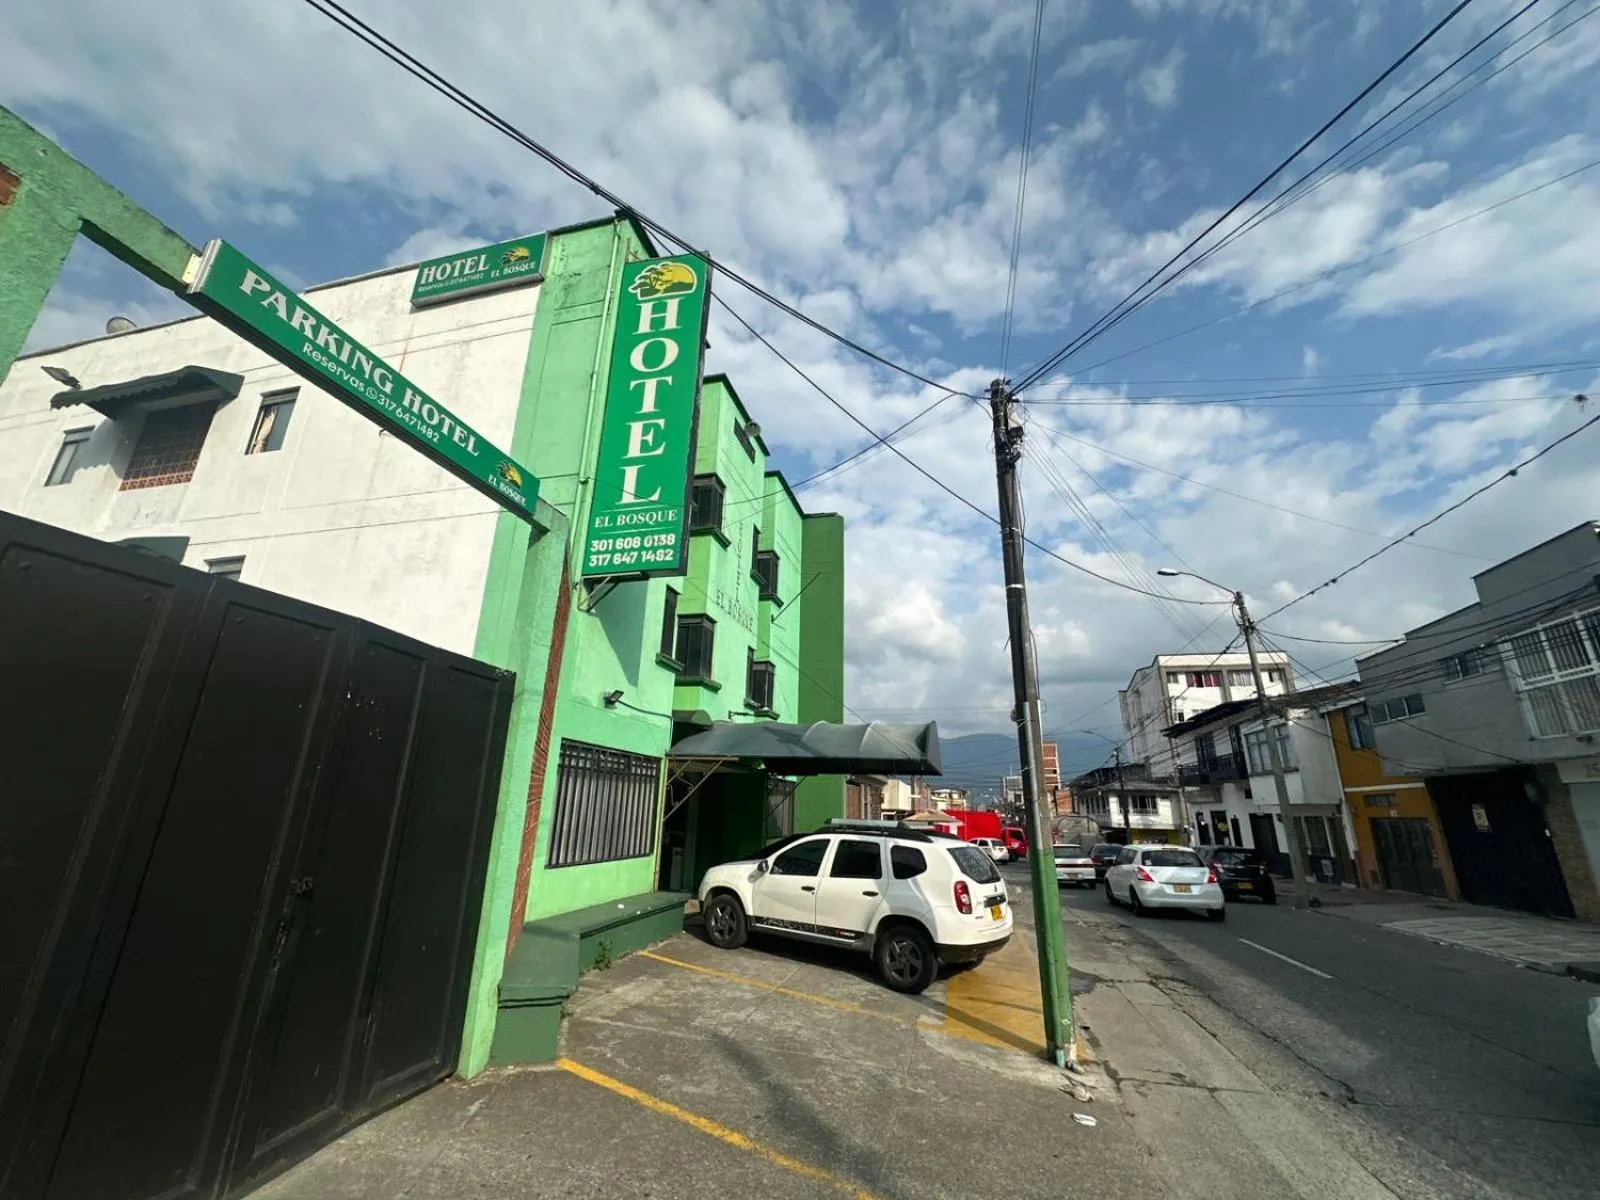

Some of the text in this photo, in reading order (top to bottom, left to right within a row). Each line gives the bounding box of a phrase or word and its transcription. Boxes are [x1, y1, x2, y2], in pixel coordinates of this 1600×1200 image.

[419, 254, 489, 285] HOTEL
[490, 261, 536, 278] EL BOSQUE
[239, 268, 480, 457] PARKING HOTEL
[302, 342, 365, 393] Reservas
[615, 297, 683, 505] HOTEL
[488, 474, 527, 506] EL BOSQUE
[594, 508, 678, 528] EL BOSQUE
[588, 548, 674, 567] 317 647 1482
[590, 538, 613, 553] 301
[643, 532, 676, 548] 0138
